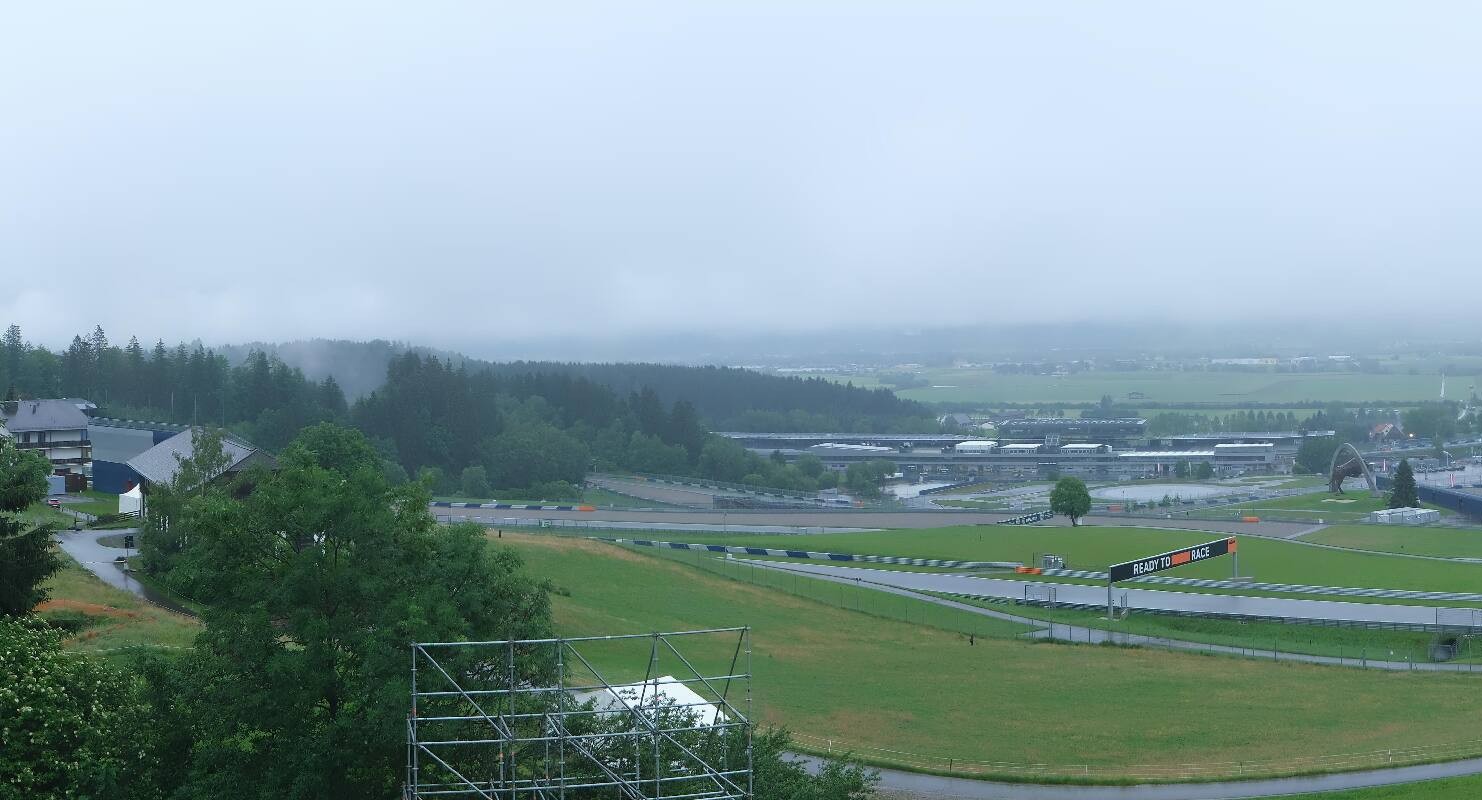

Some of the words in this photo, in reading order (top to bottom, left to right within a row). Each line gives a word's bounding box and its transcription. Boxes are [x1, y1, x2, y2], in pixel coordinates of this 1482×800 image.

[1133, 559, 1159, 575] READY
[1160, 556, 1171, 569] TO
[1191, 546, 1210, 561] RACE
